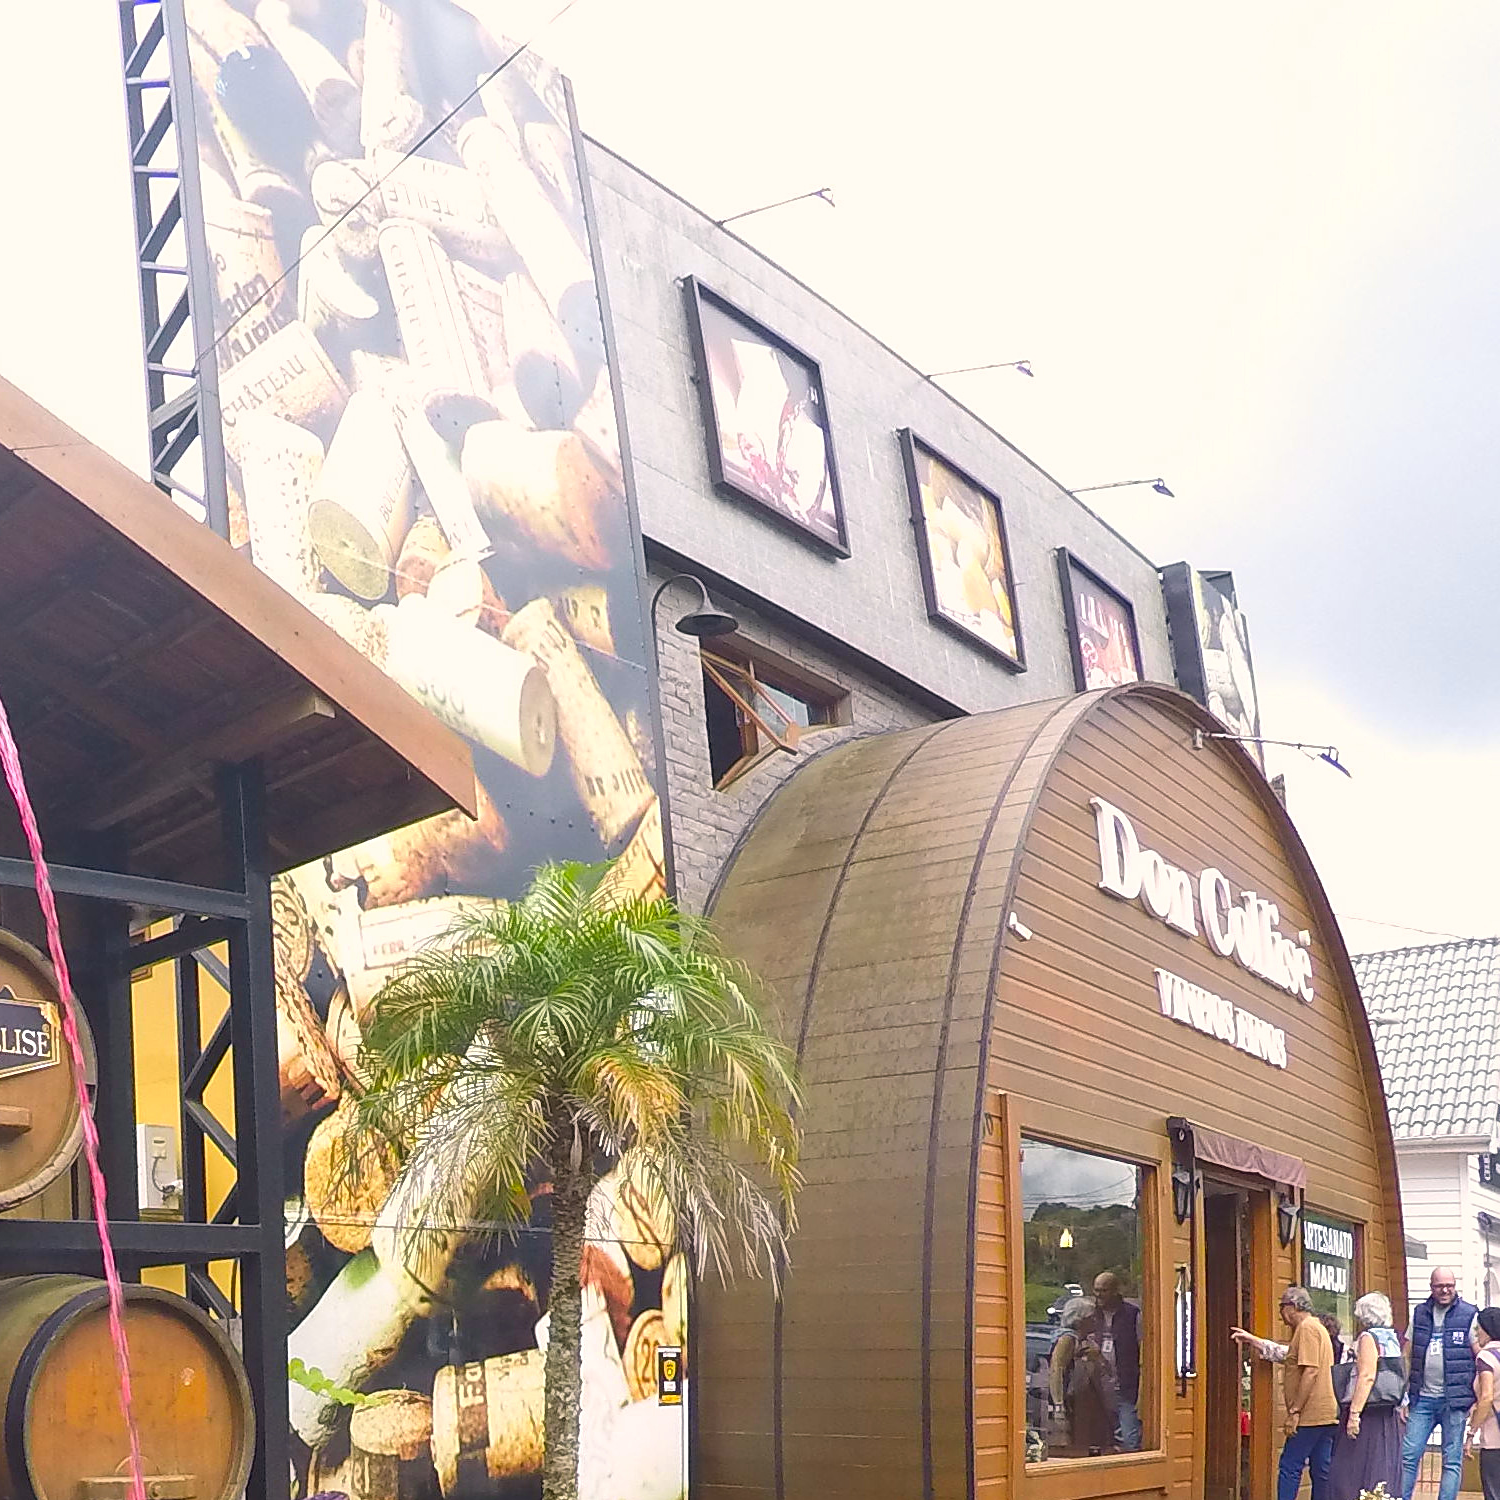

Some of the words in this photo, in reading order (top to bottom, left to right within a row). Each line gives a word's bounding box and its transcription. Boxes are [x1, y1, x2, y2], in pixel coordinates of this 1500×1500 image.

[221, 355, 306, 427] CHÂTEAU
[1089, 797, 1199, 937] Don
[1304, 1220, 1353, 1260] ARTESANATO
[1309, 1261, 1348, 1293] MARJU
